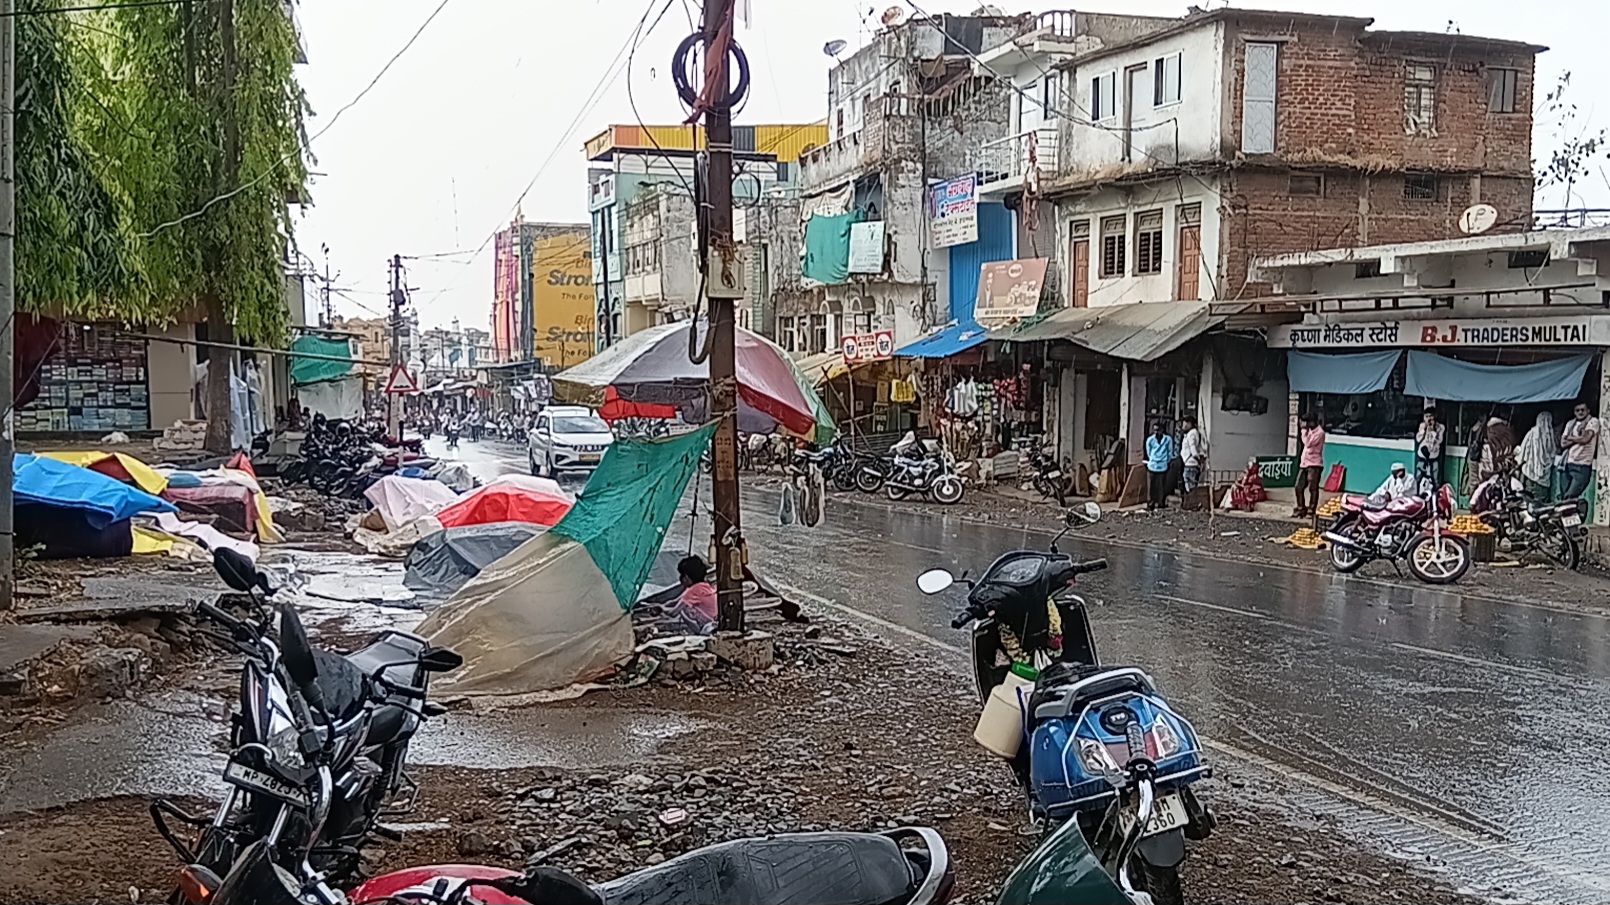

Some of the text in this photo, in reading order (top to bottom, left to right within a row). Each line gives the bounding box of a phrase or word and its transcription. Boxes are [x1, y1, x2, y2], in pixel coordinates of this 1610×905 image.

[1290, 322, 1400, 347] कृष्णा मेडिकल स्टोर्स
[1461, 327, 1530, 344] TRADERS
[1531, 324, 1587, 343] MULTAI
